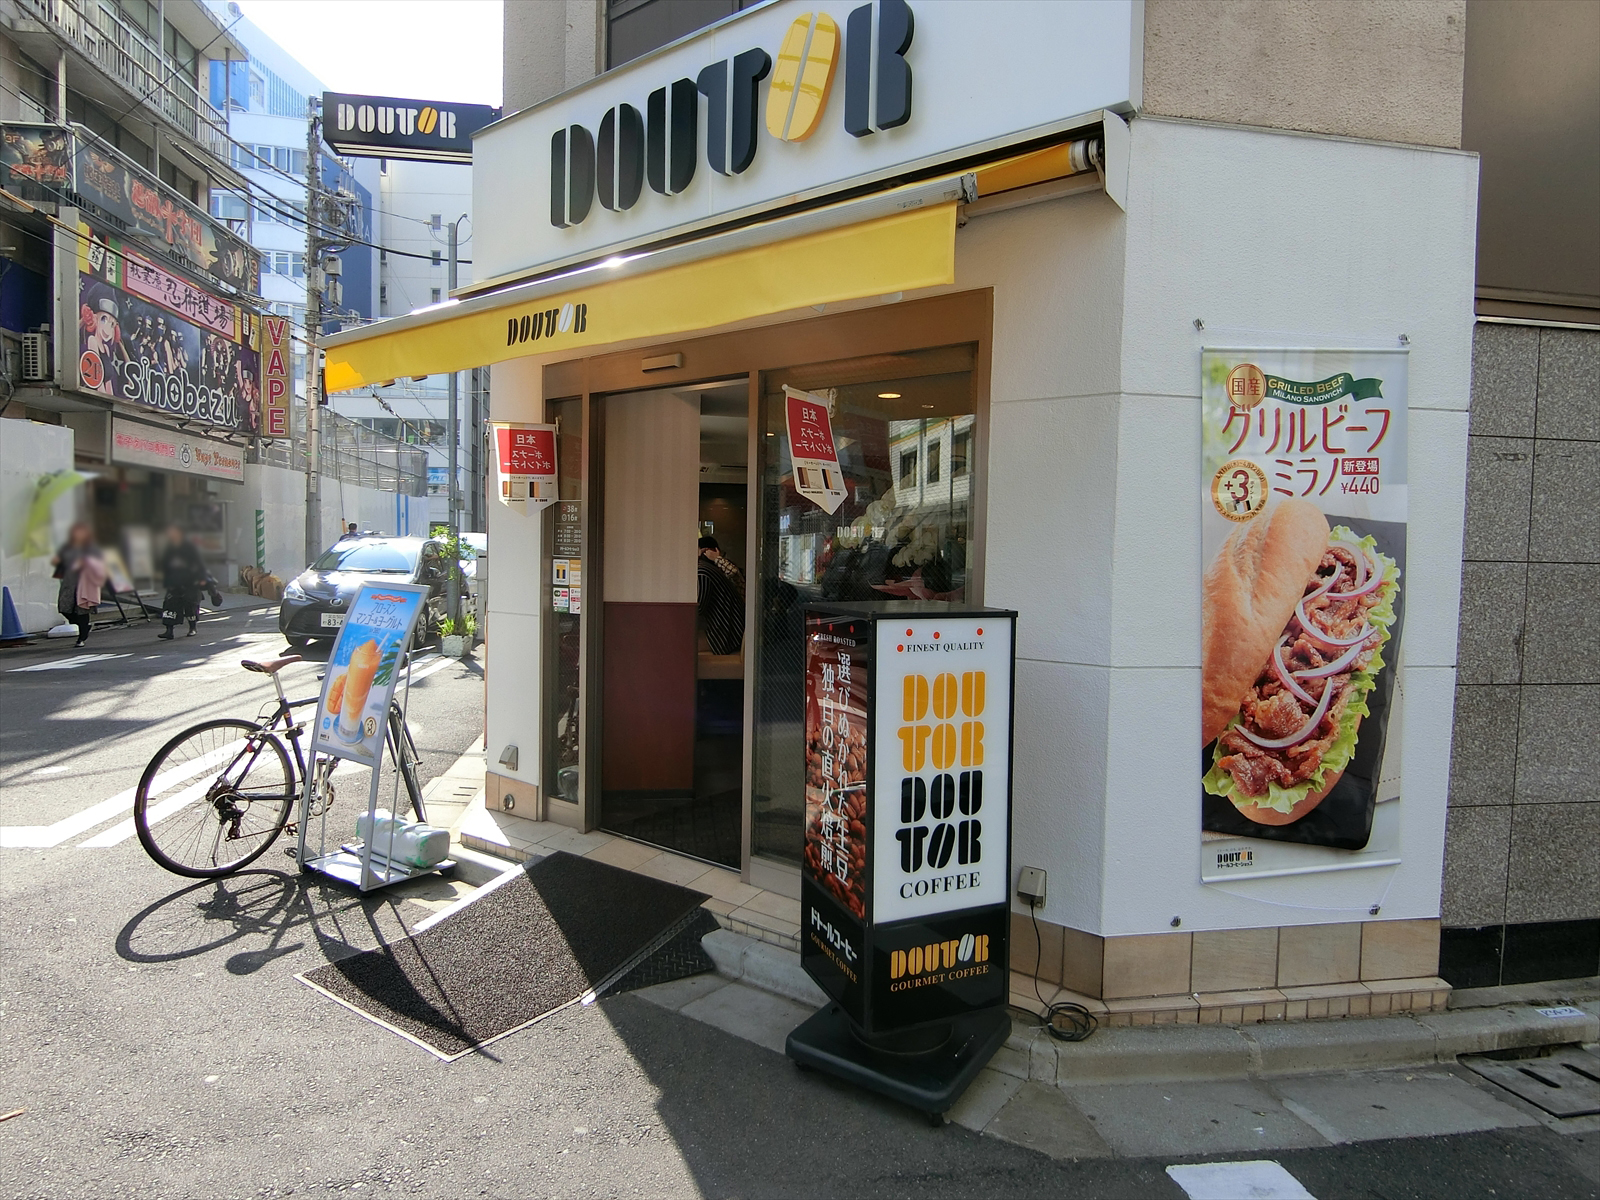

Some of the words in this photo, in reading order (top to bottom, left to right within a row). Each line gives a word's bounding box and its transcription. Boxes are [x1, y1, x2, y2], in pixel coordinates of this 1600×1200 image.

[337, 103, 457, 139] DOUTOR
[550, 0, 915, 229] DOUTOR
[507, 303, 587, 347] DOUTOR
[265, 318, 287, 435] VAPE
[1231, 377, 1260, 396] 国産
[1268, 378, 1314, 395] GRILLED
[1316, 375, 1345, 394] BEEF
[1272, 389, 1302, 402] MILANO
[1303, 387, 1343, 403] SANDWICH
[1222, 404, 1390, 455] グリルビーフ
[1224, 469, 1250, 501] +3
[1273, 457, 1339, 497] ミラノ
[1343, 460, 1378, 473] 新登場
[1340, 476, 1380, 494] ¥440
[833, 635, 857, 648] ROASTED
[906, 644, 940, 653] FINEST
[943, 641, 985, 652] QUALITY
[902, 671, 986, 722] DOU
[897, 721, 985, 773] TOR
[821, 662, 835, 873] 独自の直火焙煎
[836, 651, 852, 886] 選びぬかれた生豆
[901, 770, 983, 823] DOU
[895, 819, 982, 873] TOR
[1217, 851, 1253, 864] DOUTOR
[899, 871, 981, 899] COFFEE
[811, 906, 858, 961] ドトールコーヒー
[836, 956, 858, 984] COFFEE
[890, 933, 989, 979] DOUTOR
[890, 973, 946, 993] GOURMET
[948, 964, 989, 981] COFFEE
